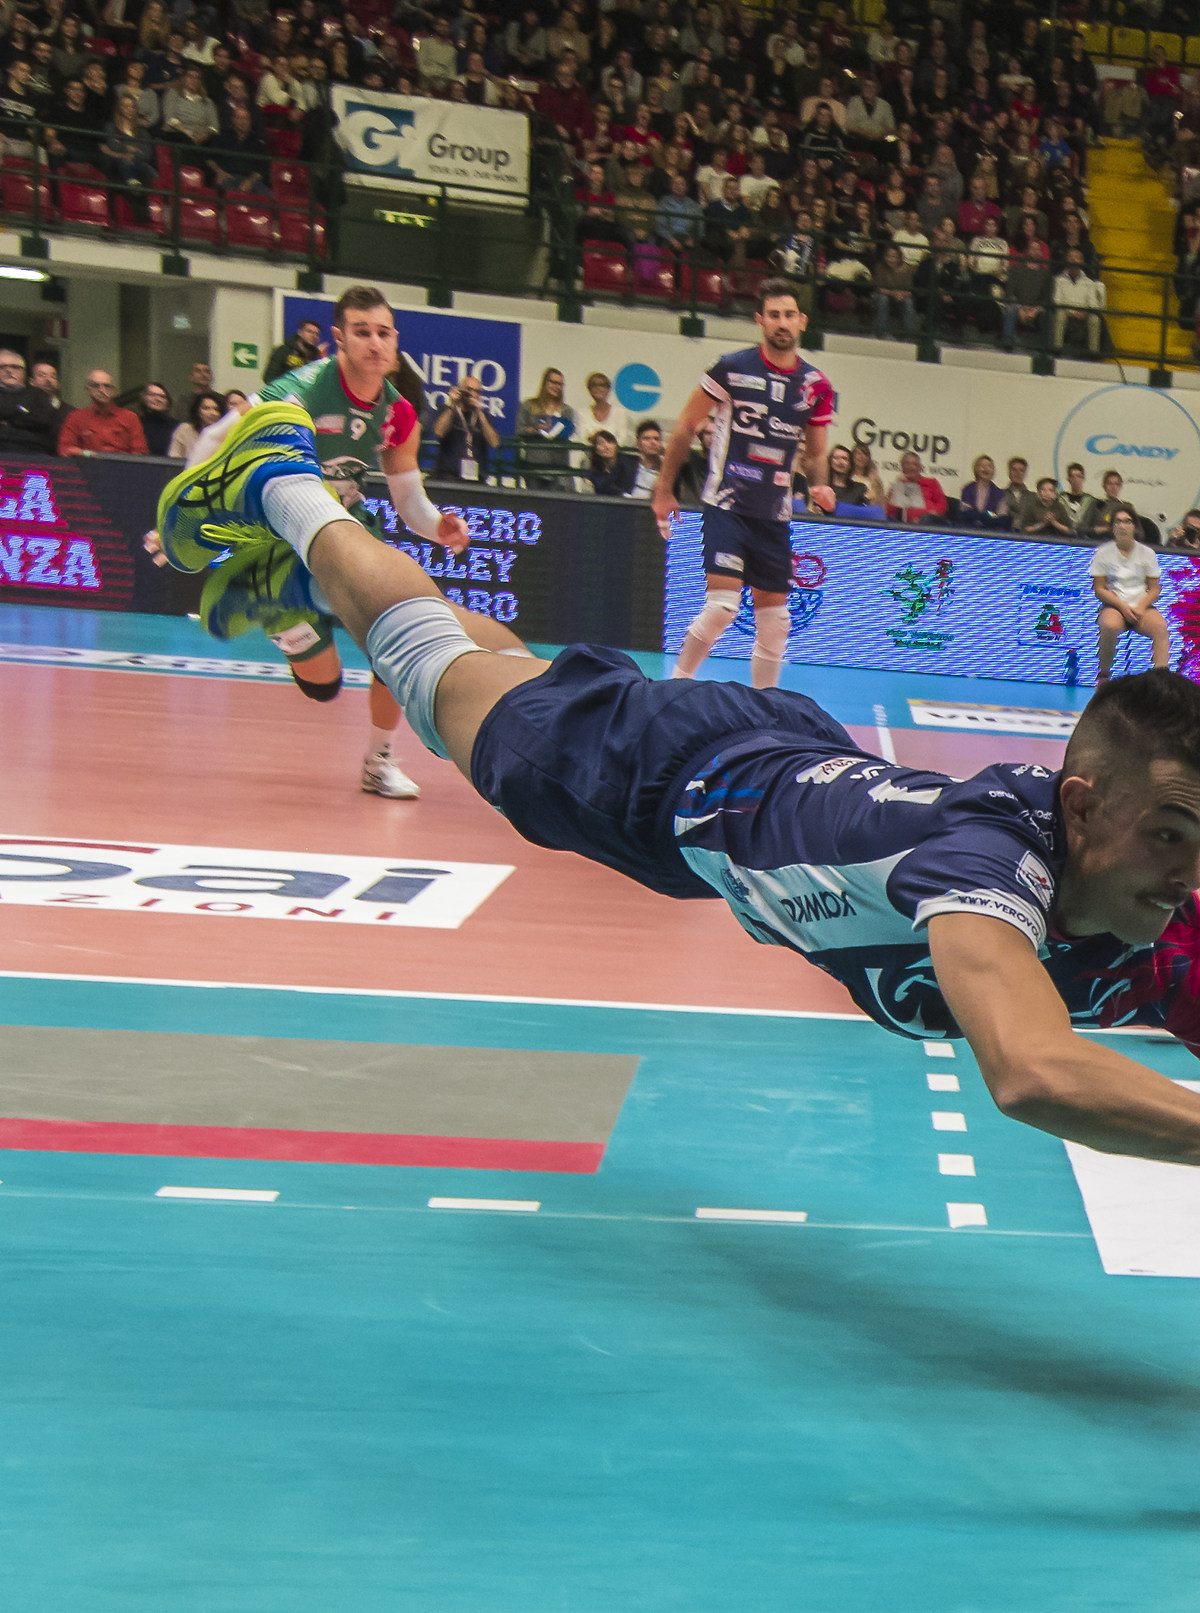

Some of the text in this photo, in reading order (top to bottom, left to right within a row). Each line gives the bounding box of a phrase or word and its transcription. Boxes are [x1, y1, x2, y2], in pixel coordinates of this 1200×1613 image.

[427, 132, 511, 171] Group
[350, 418, 367, 441] 9
[851, 417, 950, 463] Group
